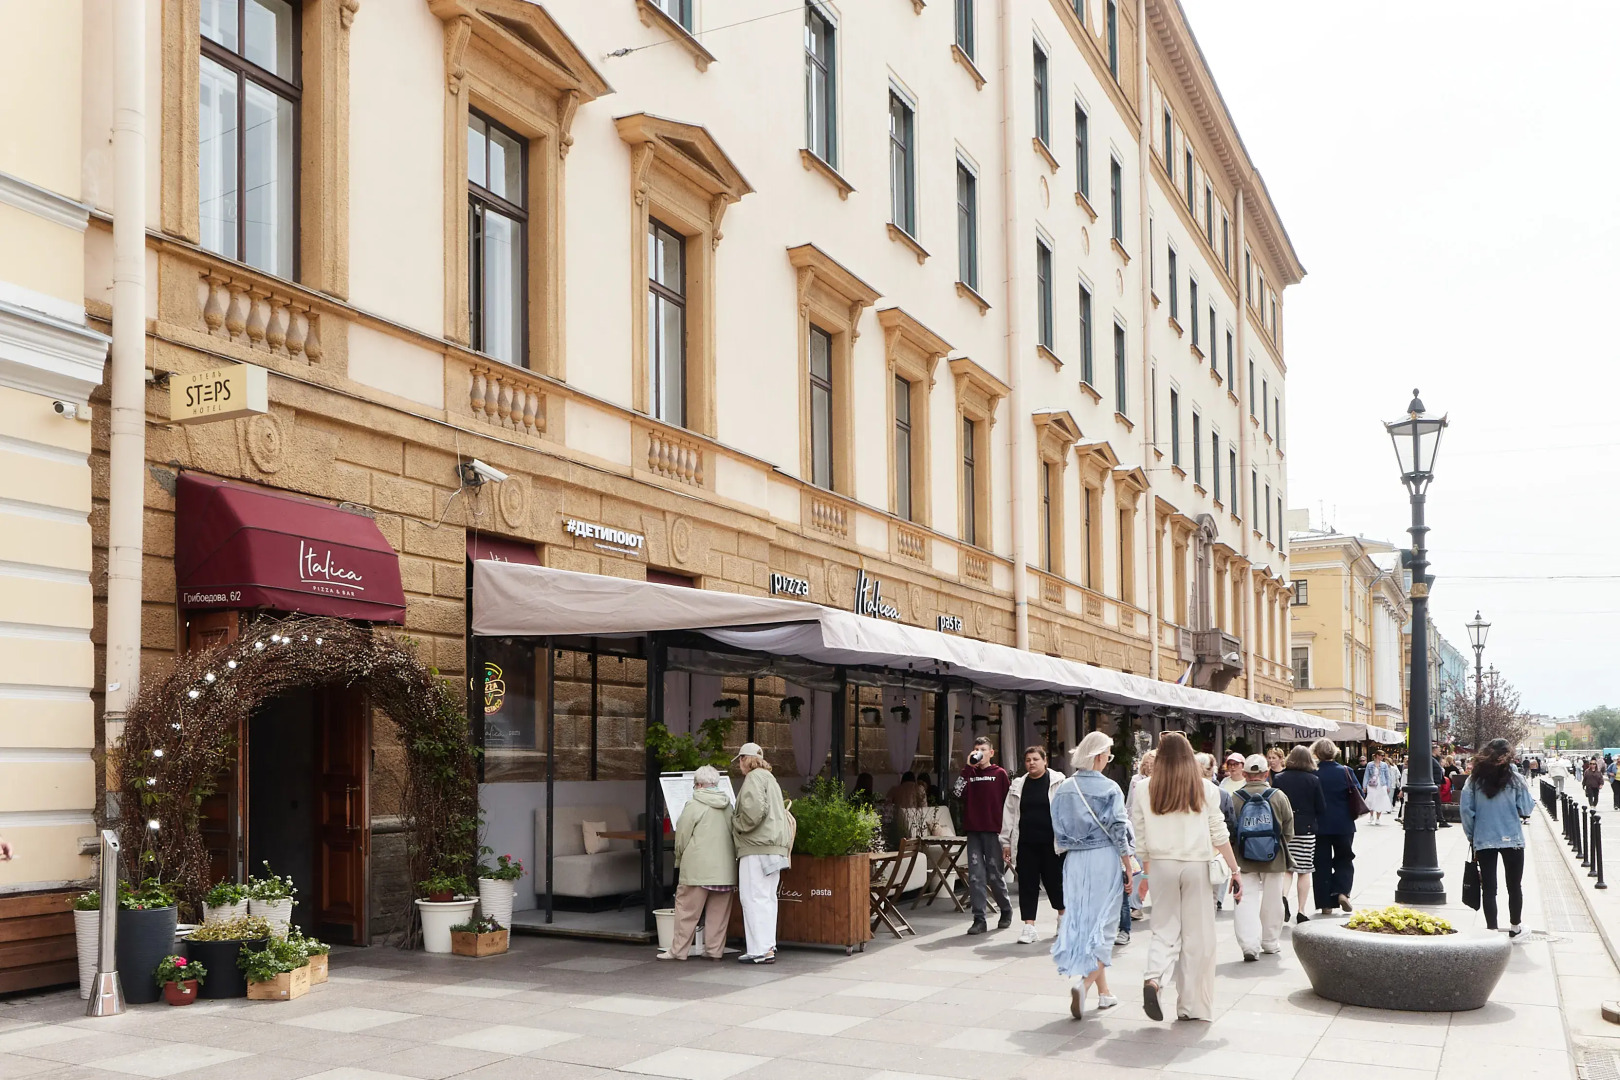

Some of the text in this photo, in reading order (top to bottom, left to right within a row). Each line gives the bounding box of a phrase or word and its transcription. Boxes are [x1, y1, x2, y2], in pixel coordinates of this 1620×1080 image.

[192, 371, 222, 382] ОТЕЛЬ
[186, 379, 231, 407] STEPS
[193, 404, 222, 415] HOTEL
[567, 519, 644, 548] #ДЕТИПОЮТ
[299, 540, 363, 581] Italica
[312, 585, 334, 594] PIZZA
[770, 573, 809, 596] pizza
[183, 590, 241, 604] Грибоедова, 6/2
[855, 569, 901, 619] Italica
[936, 615, 962, 632] pasta
[811, 888, 832, 897] pasta
